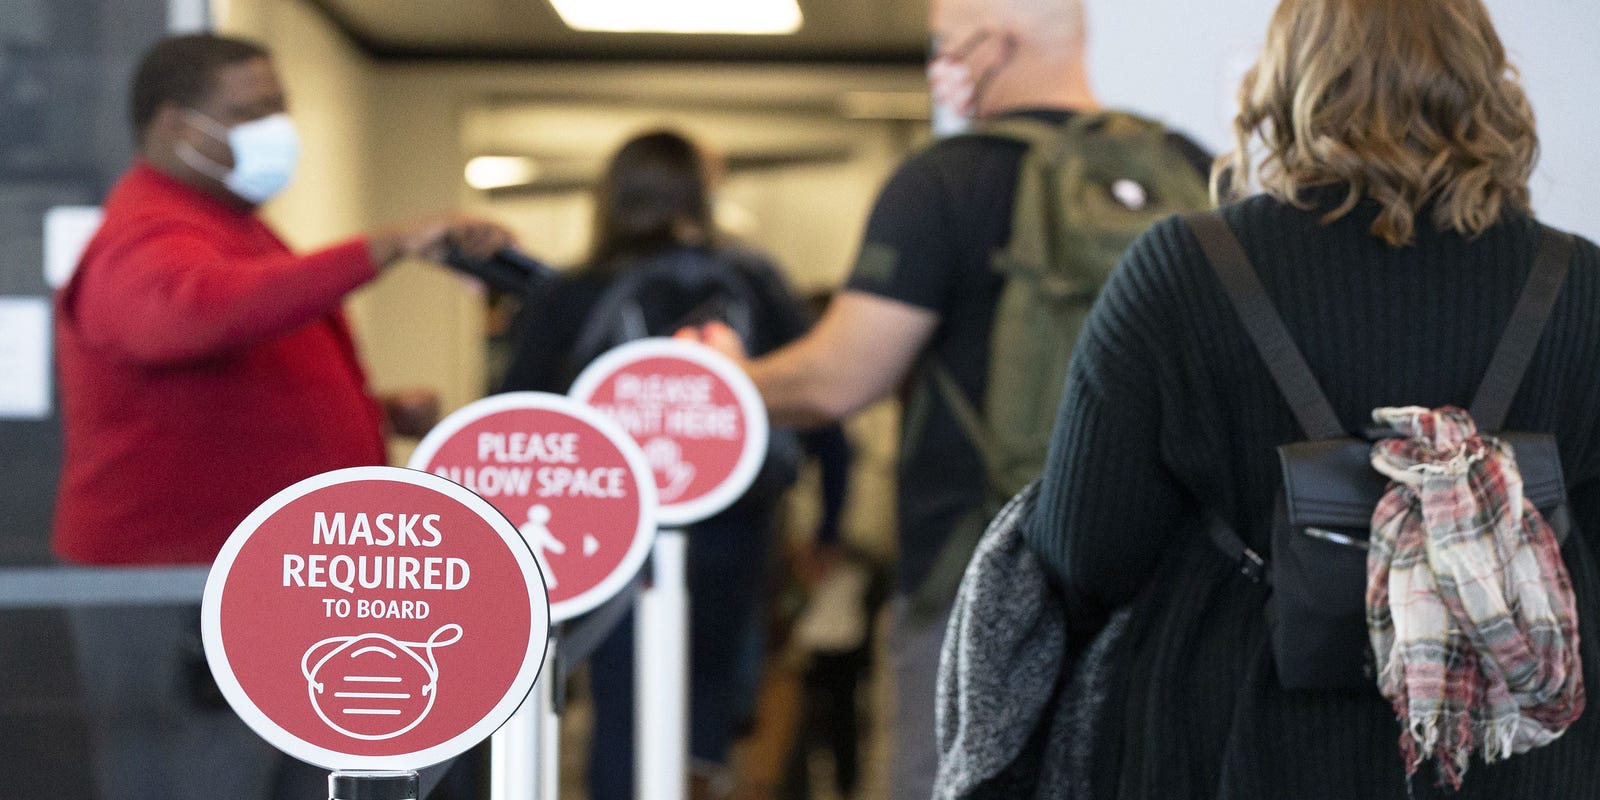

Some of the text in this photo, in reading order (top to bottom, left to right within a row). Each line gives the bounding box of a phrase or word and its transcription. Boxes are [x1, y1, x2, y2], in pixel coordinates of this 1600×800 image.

[478, 433, 579, 463] PLEASE
[537, 467, 625, 498] SPACE
[312, 512, 442, 547] MASKS
[282, 554, 470, 594] REQUIRED
[322, 598, 430, 619] TO BOARD
